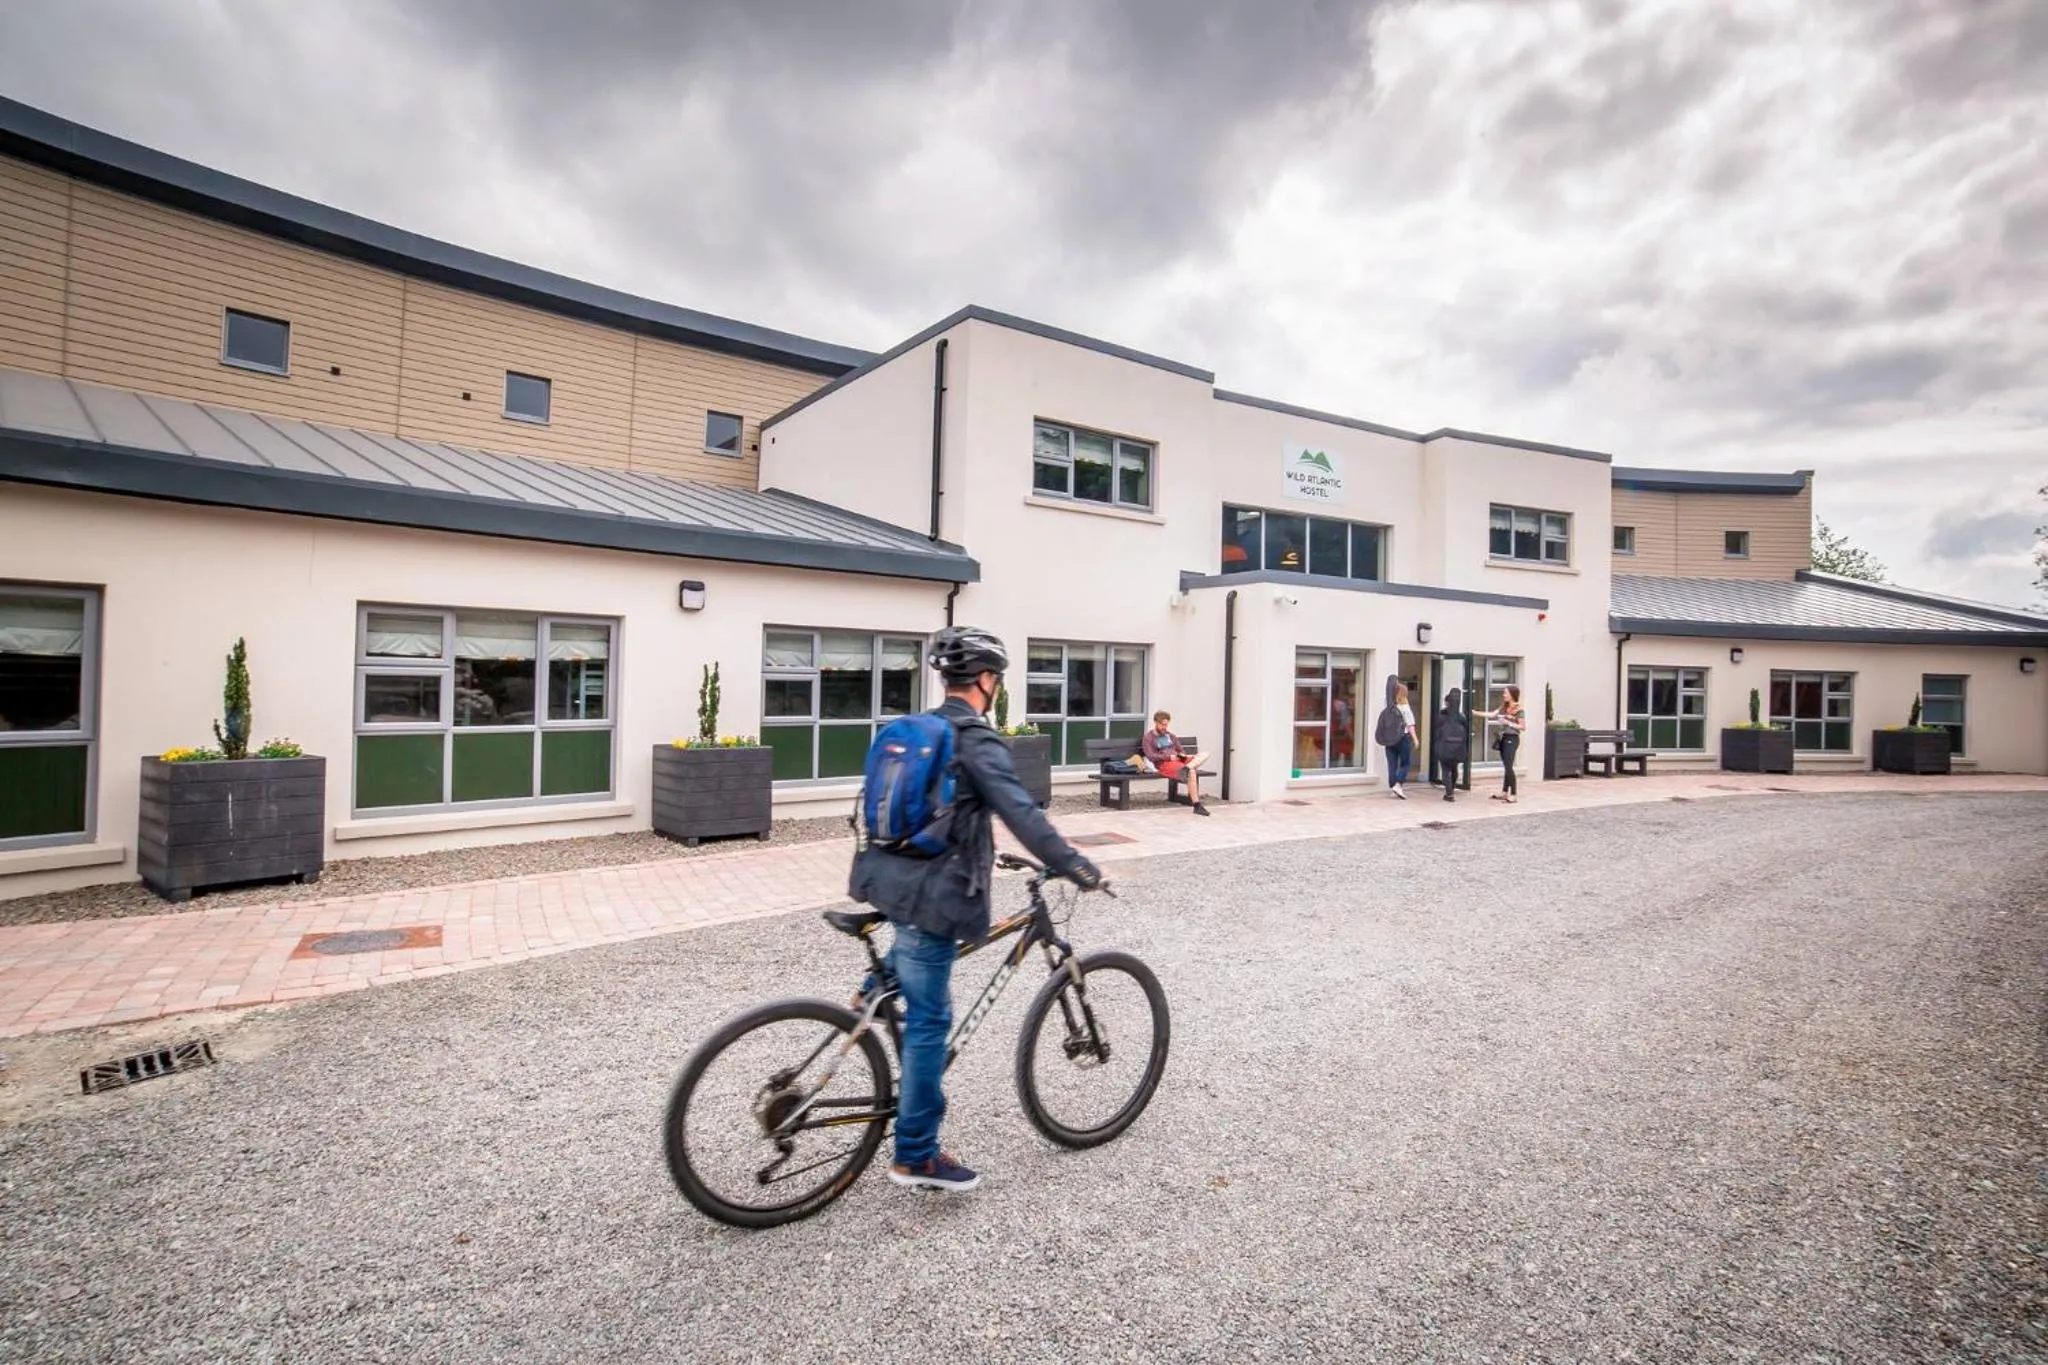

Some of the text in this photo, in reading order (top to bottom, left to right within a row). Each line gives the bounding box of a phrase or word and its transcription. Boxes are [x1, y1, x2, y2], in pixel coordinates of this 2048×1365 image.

[1286, 471, 1342, 488] WILD ATLANTIC
[1299, 486, 1330, 498] HOSTEL
